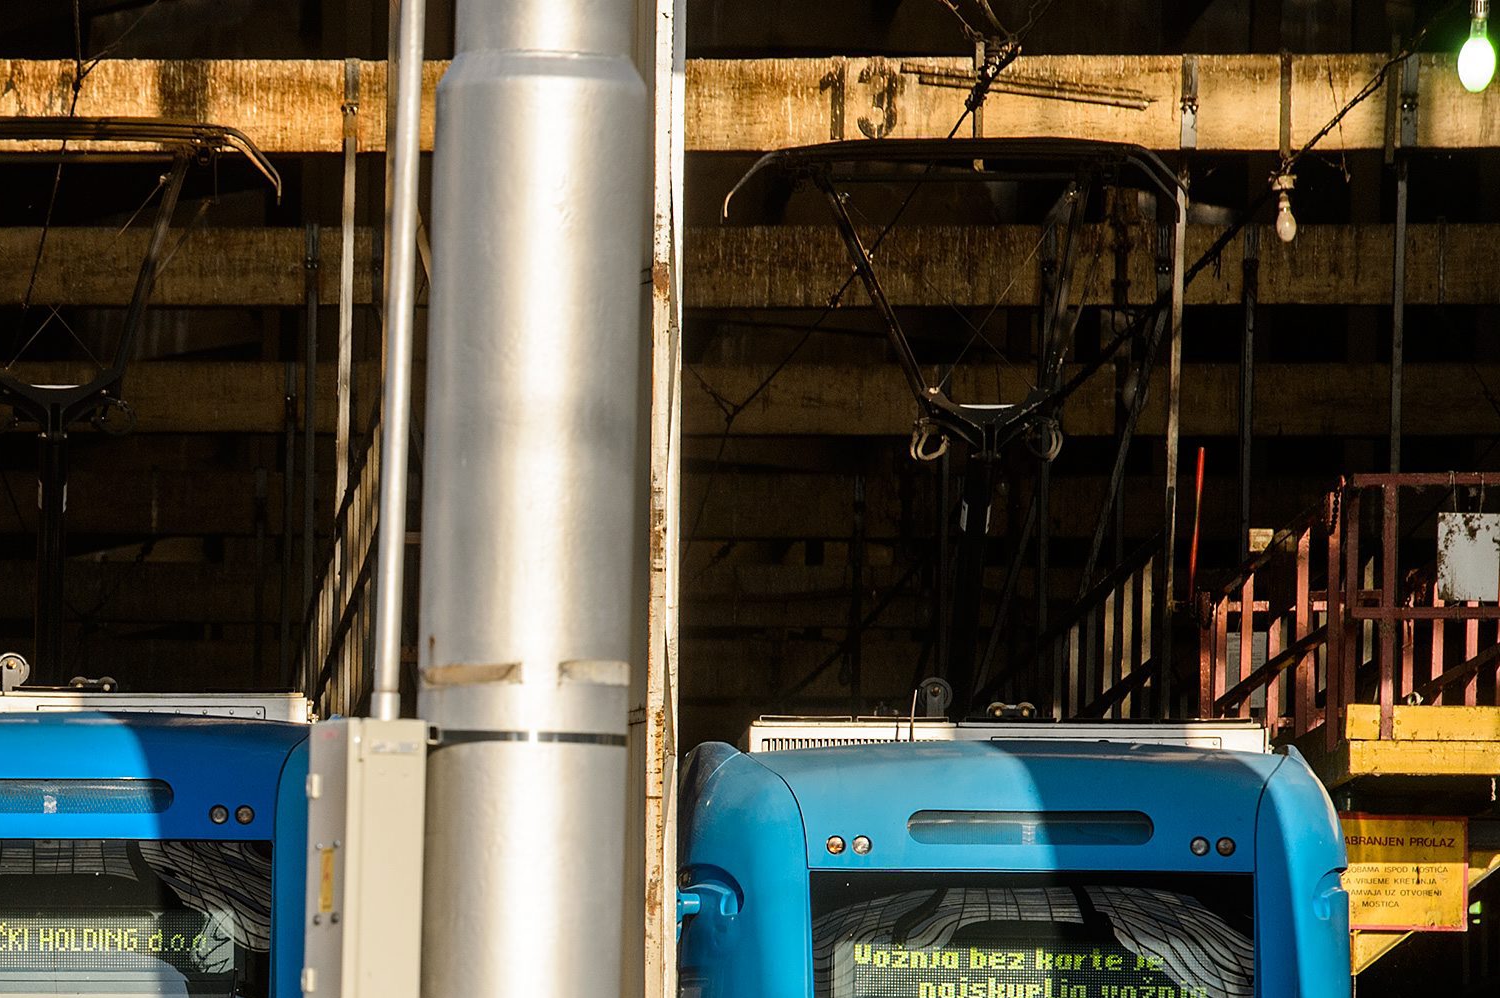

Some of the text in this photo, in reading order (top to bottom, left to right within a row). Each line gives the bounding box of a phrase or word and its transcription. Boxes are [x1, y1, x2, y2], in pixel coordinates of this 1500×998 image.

[819, 60, 898, 140] 13
[1345, 836, 1456, 848] ABRANJEN PROLAZ
[1399, 889, 1443, 897] OTVORENI
[39, 928, 139, 951] HOLDING
[970, 946, 1026, 970] bez
[1035, 948, 1124, 971] karte
